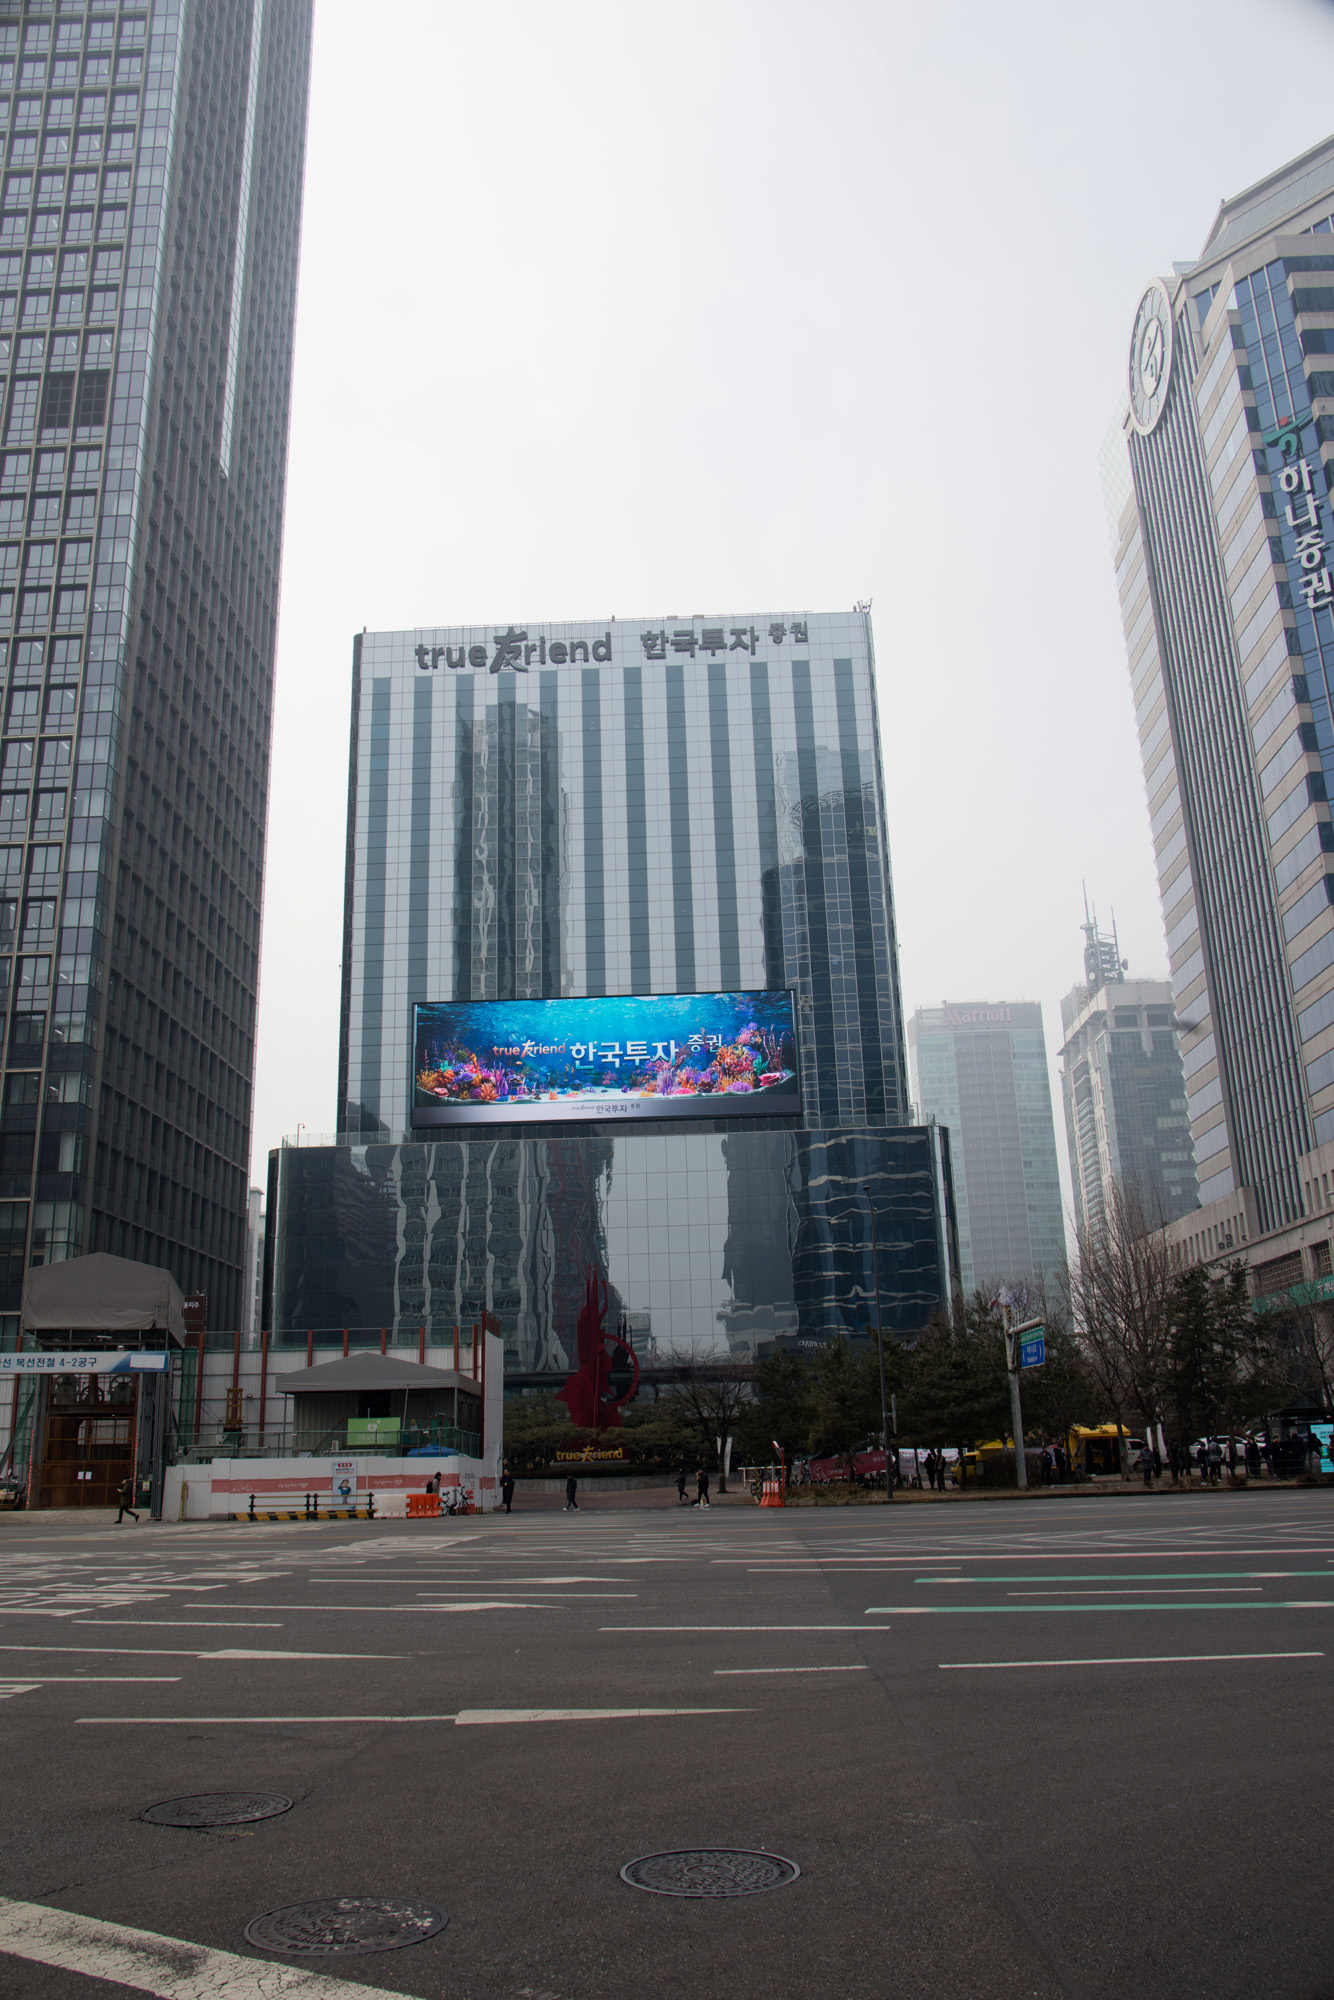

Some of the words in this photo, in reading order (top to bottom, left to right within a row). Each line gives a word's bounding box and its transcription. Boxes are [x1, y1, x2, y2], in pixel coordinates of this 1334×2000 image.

[1277, 458, 1334, 609] 하나증권
[640, 626, 760, 660] 한국투자
[768, 621, 808, 644] 증권
[942, 1007, 1011, 1027] Marriott
[569, 1040, 680, 1070] 한국투자
[687, 1034, 722, 1053] 증권
[596, 1104, 628, 1114] 한국투자
[0, 1358, 11, 1368] 선
[16, 1357, 55, 1368] 복선전철
[59, 1357, 97, 1368] 4-2공구
